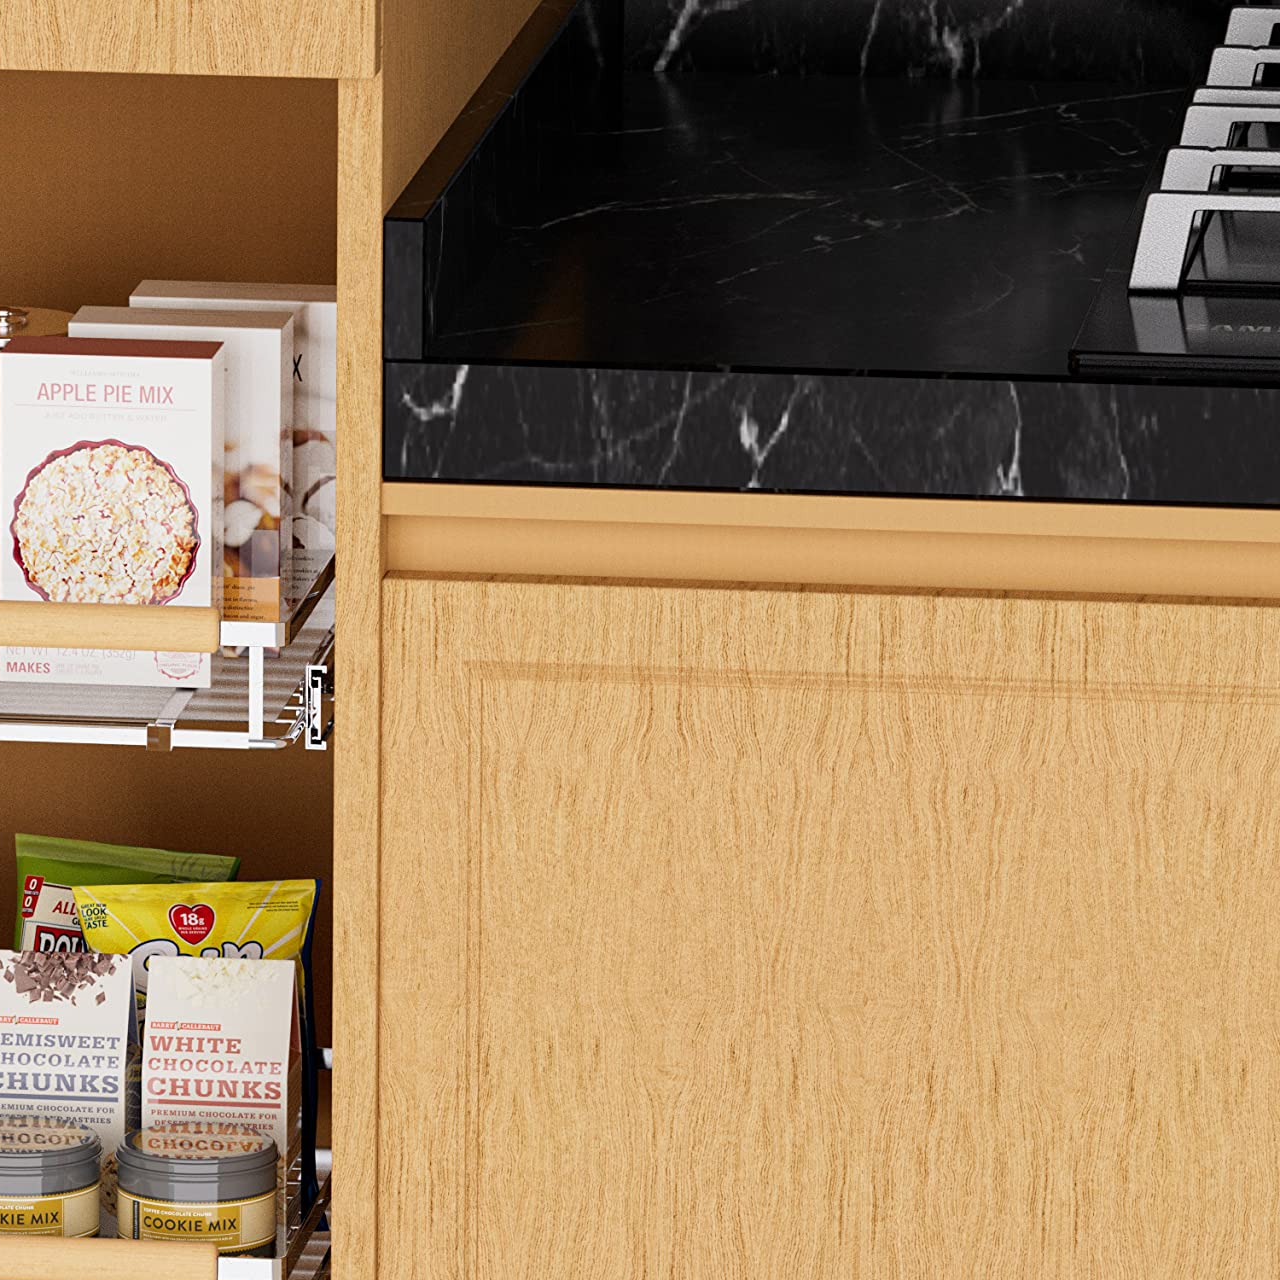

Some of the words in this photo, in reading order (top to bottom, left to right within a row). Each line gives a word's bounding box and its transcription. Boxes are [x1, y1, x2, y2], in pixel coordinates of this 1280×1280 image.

[37, 382, 97, 402] APPLE
[104, 384, 132, 403] PIE
[139, 385, 174, 405] MIX
[6, 661, 51, 673] MAKES
[29, 879, 37, 890] 0
[24, 895, 32, 907] 0
[81, 907, 107, 918] LOOK
[180, 912, 205, 926] 18g
[149, 1035, 241, 1054] WHITE
[148, 1057, 282, 1075] CHOCOLATE
[147, 1077, 282, 1100] CHUNKS
[36, 1105, 93, 1114] CHOCOLATE
[151, 1109, 196, 1117] PREMIUM
[199, 1110, 256, 1119] CHOCOLATE
[259, 1112, 278, 1120] FOR
[30, 1211, 59, 1225] MIX
[160, 1209, 192, 1217] CHOCOLATE
[143, 1215, 202, 1232] COOKIE
[208, 1218, 237, 1232] MIX
